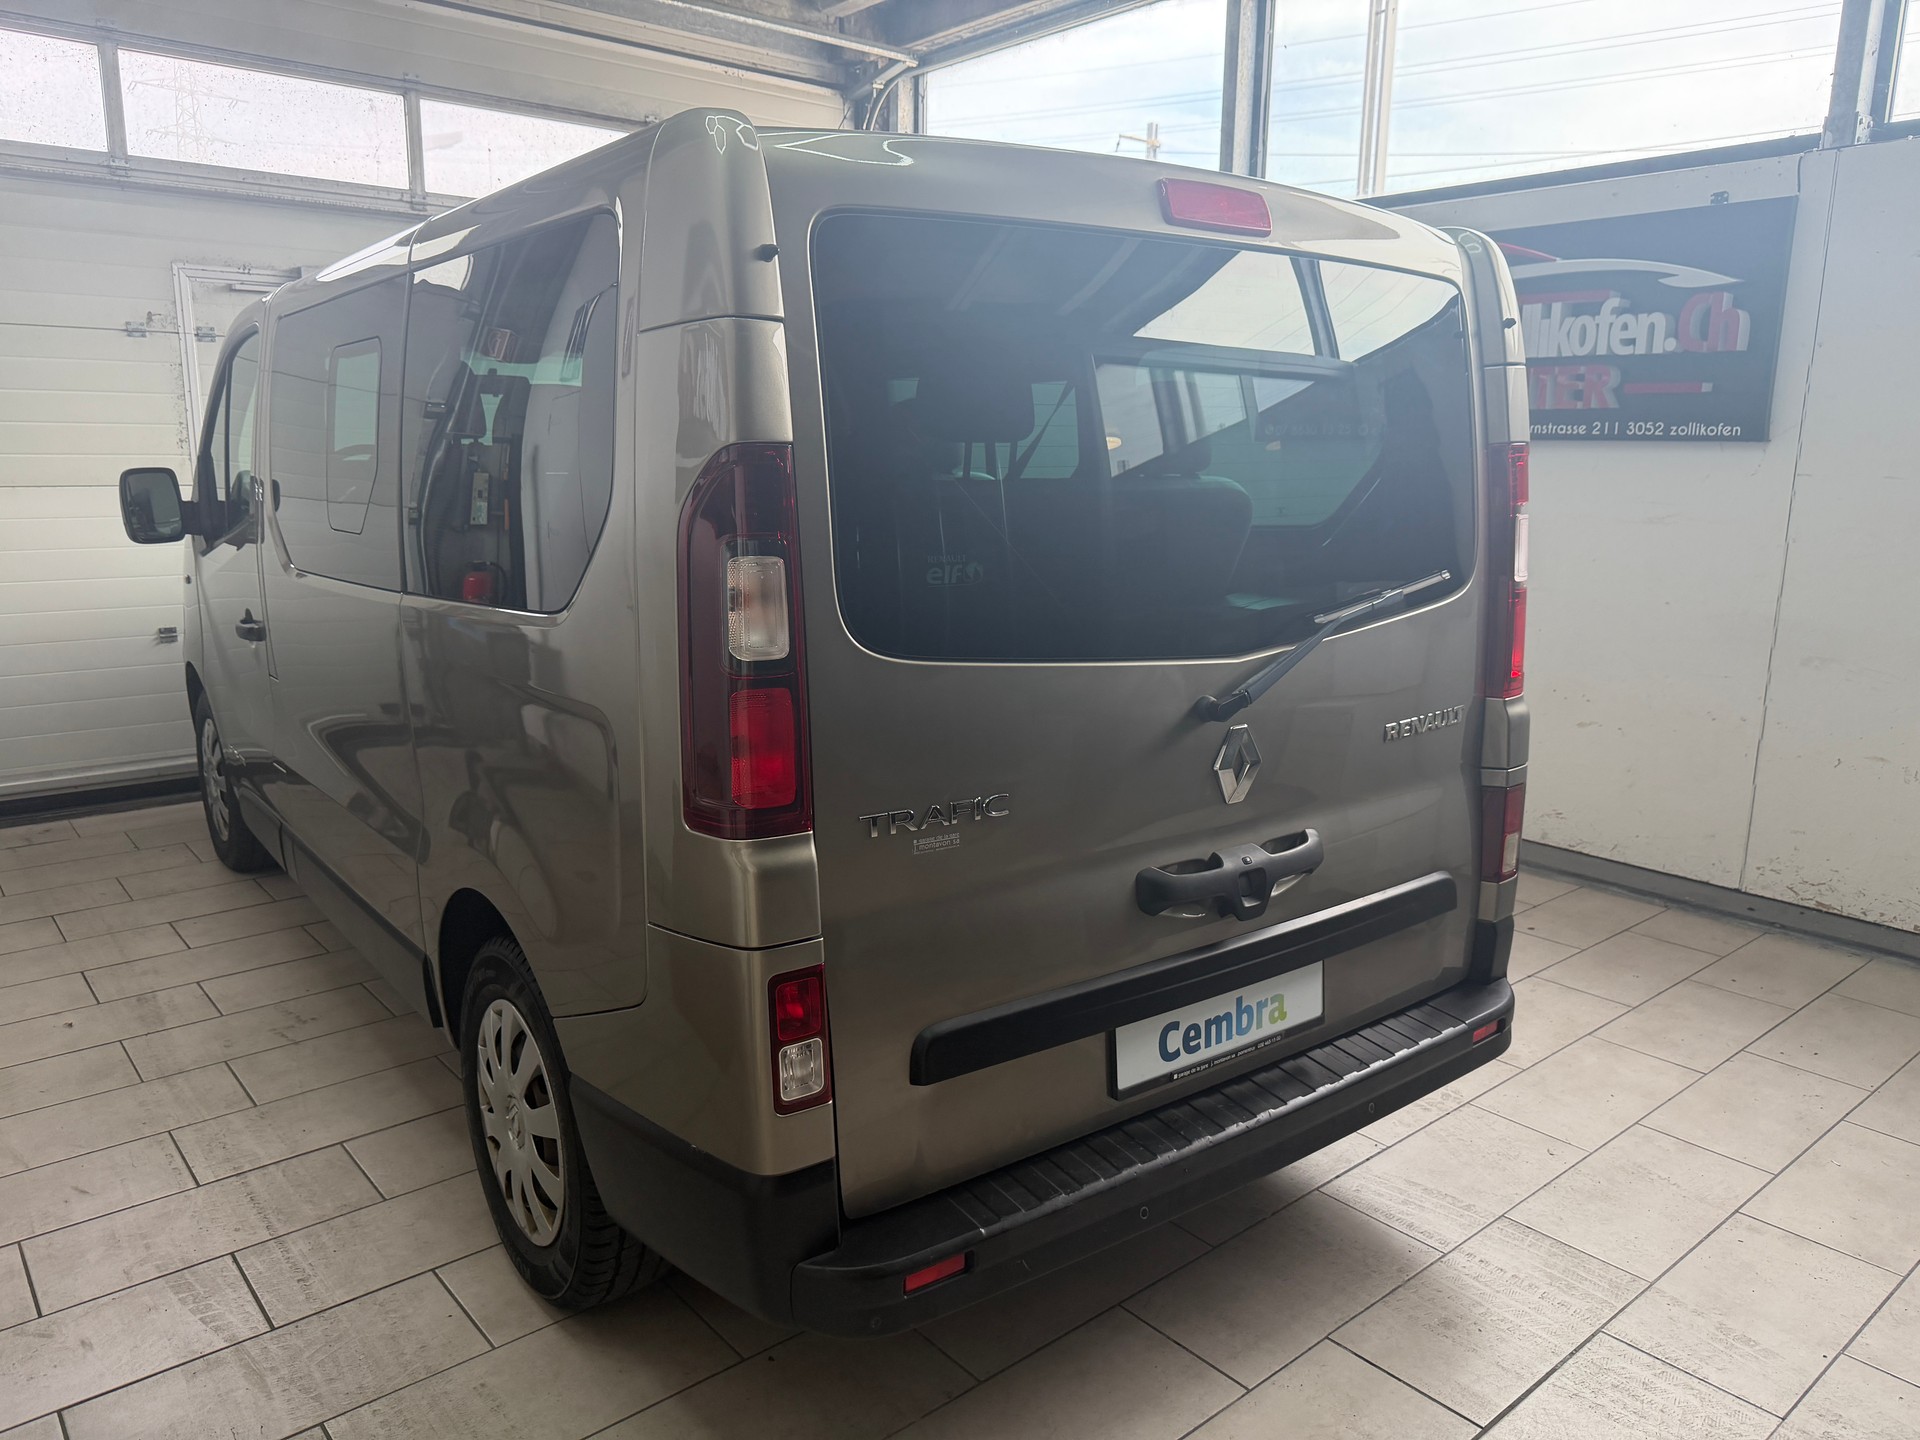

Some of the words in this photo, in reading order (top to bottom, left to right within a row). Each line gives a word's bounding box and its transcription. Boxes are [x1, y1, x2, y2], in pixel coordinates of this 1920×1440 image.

[1592, 421, 1619, 435] 211
[1626, 421, 1664, 435] 3052
[1669, 421, 1742, 437] zollikofen
[1383, 704, 1465, 743] RENAULT
[859, 793, 1010, 838] TRAFIC
[1158, 993, 1287, 1063] Cembra
